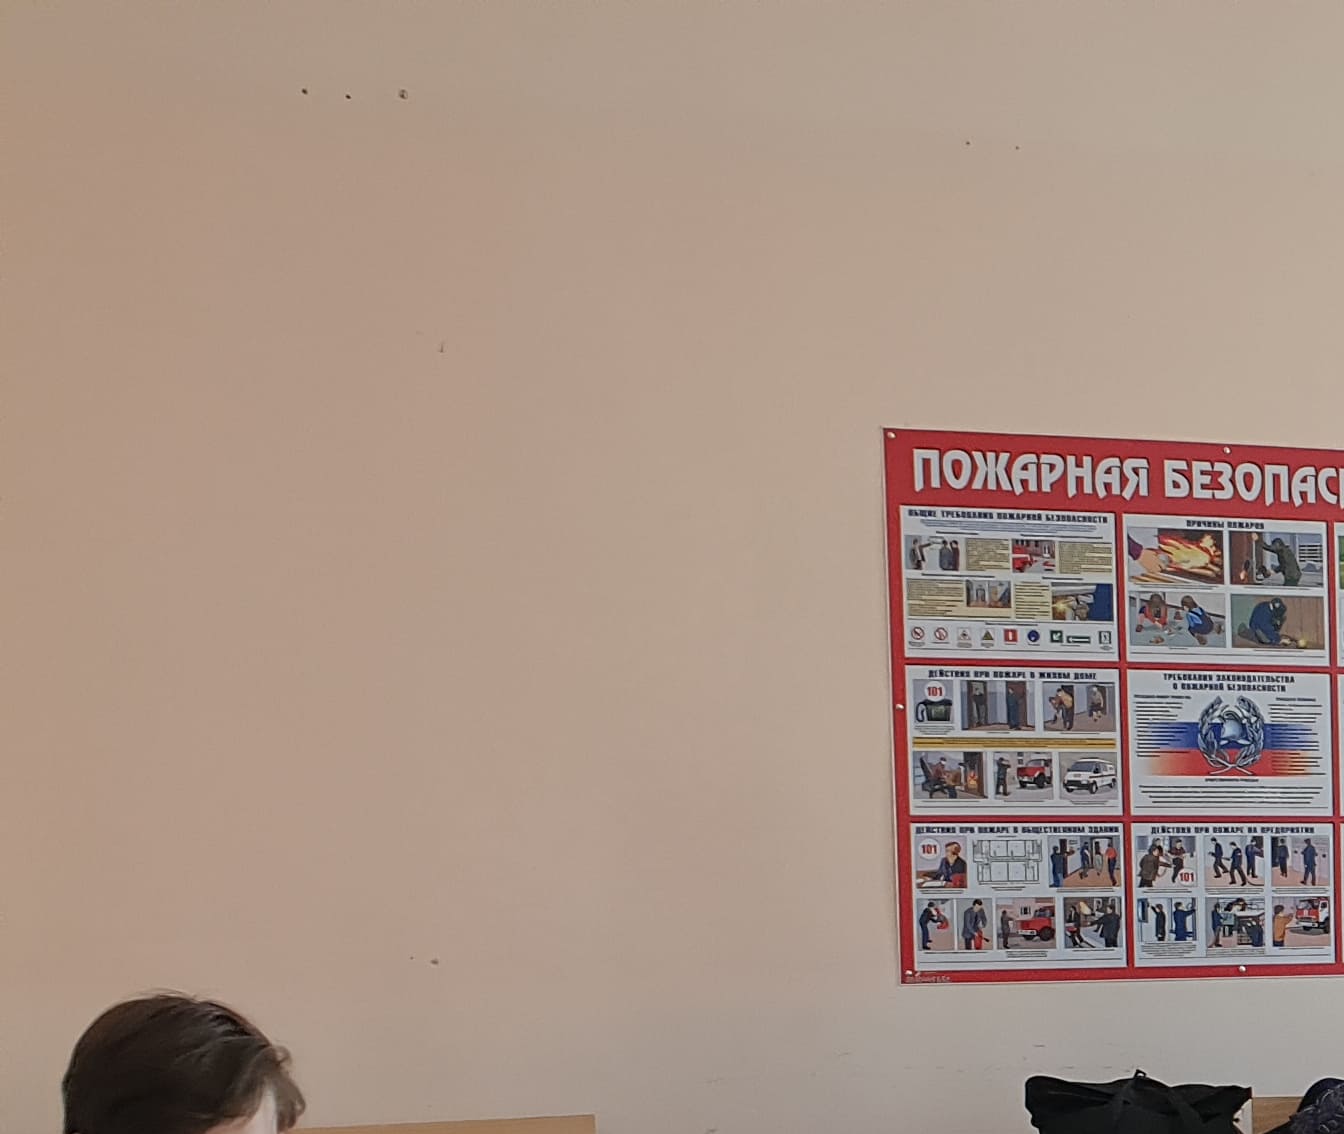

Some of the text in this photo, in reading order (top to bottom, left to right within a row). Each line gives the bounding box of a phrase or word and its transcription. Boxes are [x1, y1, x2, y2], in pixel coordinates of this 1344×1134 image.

[912, 447, 1150, 500] ПОЖАРНАЯ
[927, 686, 943, 697] 101
[921, 844, 937, 854] 101
[1179, 871, 1194, 882] 101
